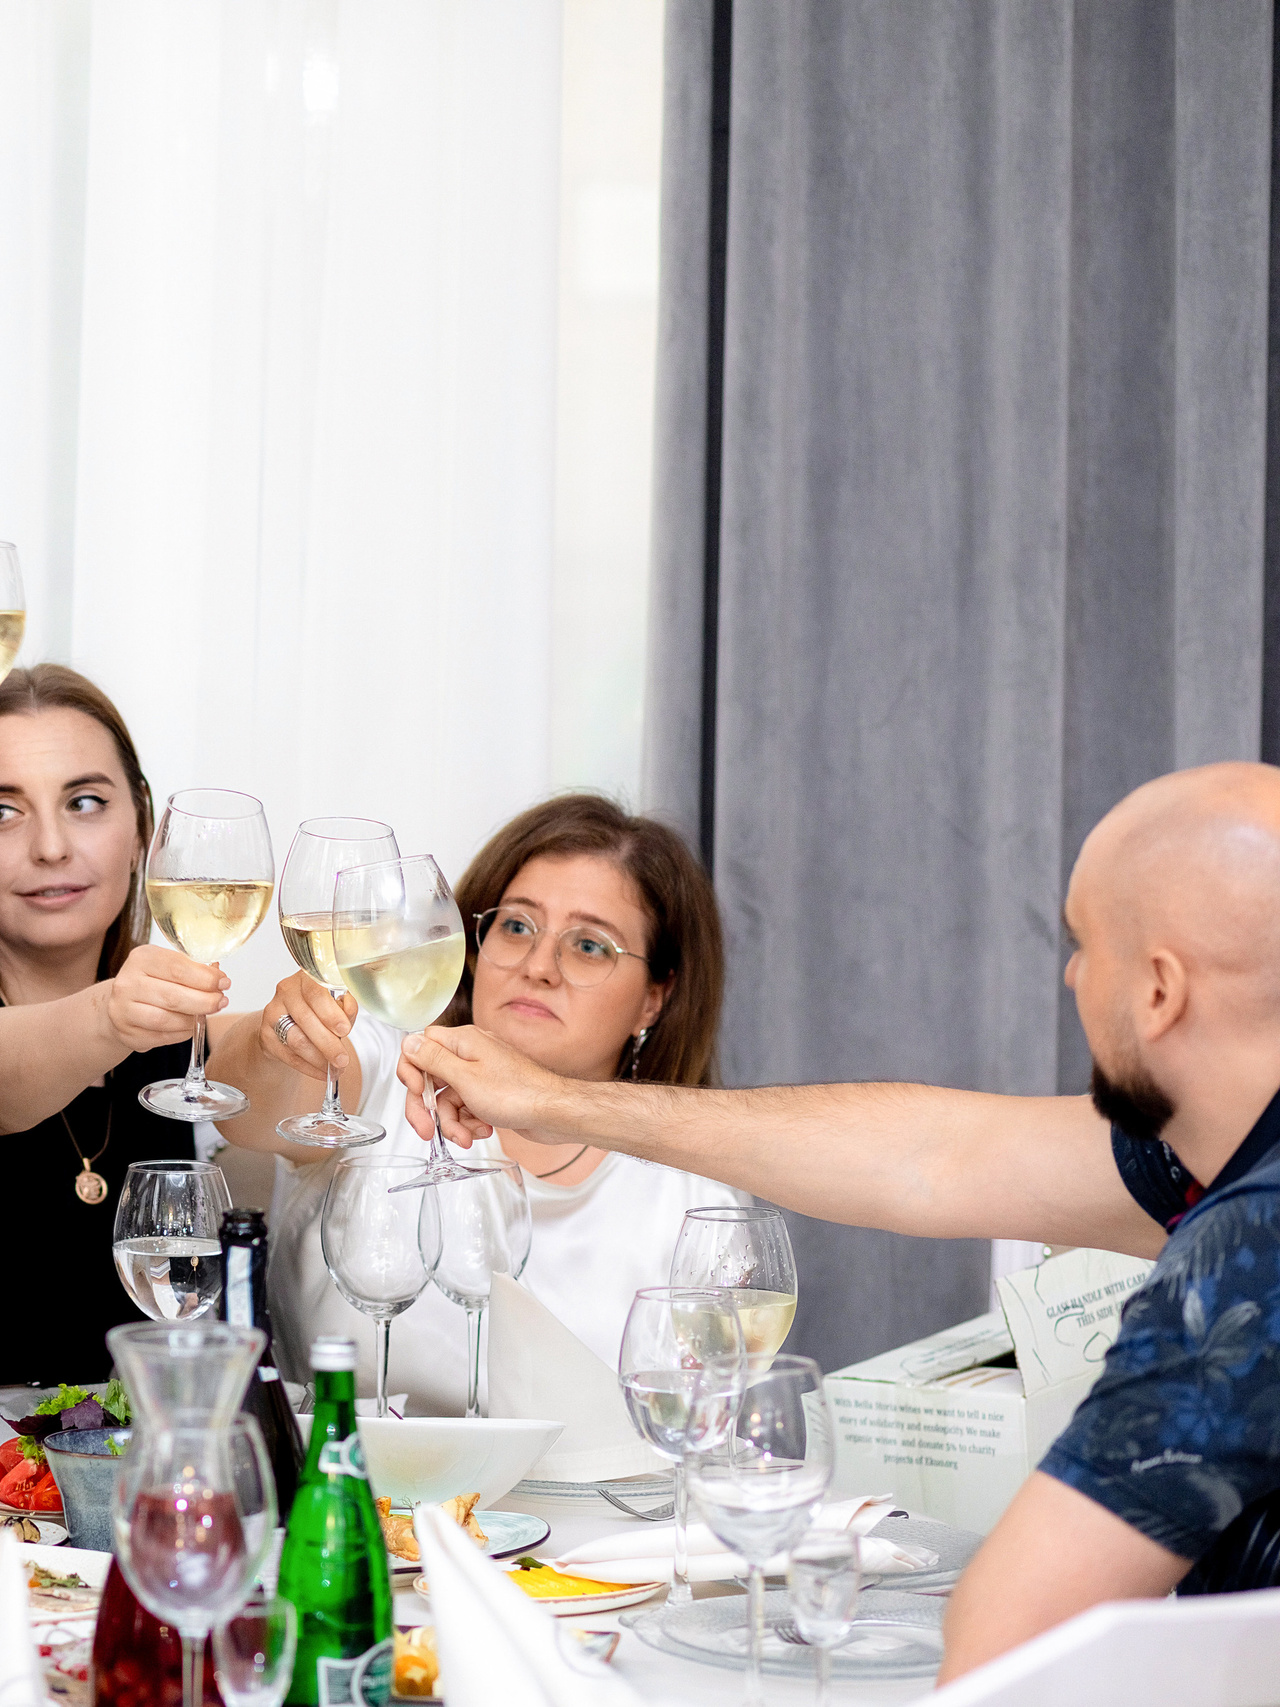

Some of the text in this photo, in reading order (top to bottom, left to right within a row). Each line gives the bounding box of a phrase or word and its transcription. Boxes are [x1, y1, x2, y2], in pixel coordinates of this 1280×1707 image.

[1046, 1303, 1070, 1318] GLASS
[1070, 1289, 1102, 1308] HANDLE
[1103, 1280, 1126, 1296] WITH
[1076, 1313, 1096, 1329] THIS
[1096, 1304, 1114, 1321] SIDE
[834, 1398, 852, 1408] With
[854, 1399, 873, 1409] Bella
[899, 1404, 922, 1414] wines
[936, 1408, 955, 1417] want
[957, 1409, 966, 1418] to
[966, 1409, 980, 1419] tell
[988, 1411, 1005, 1422] nice
[839, 1416, 858, 1427] story
[860, 1416, 868, 1426] of
[869, 1418, 904, 1430] solidarity
[906, 1421, 922, 1431] and
[966, 1426, 978, 1436] We
[979, 1427, 1002, 1439] make
[844, 1433, 873, 1444] organic
[875, 1437, 898, 1446] wines
[901, 1438, 916, 1447] and
[918, 1439, 944, 1450] donate
[958, 1443, 968, 1452] to
[968, 1443, 996, 1457] charity
[884, 1453, 914, 1465] projects
[915, 1455, 924, 1465] of
